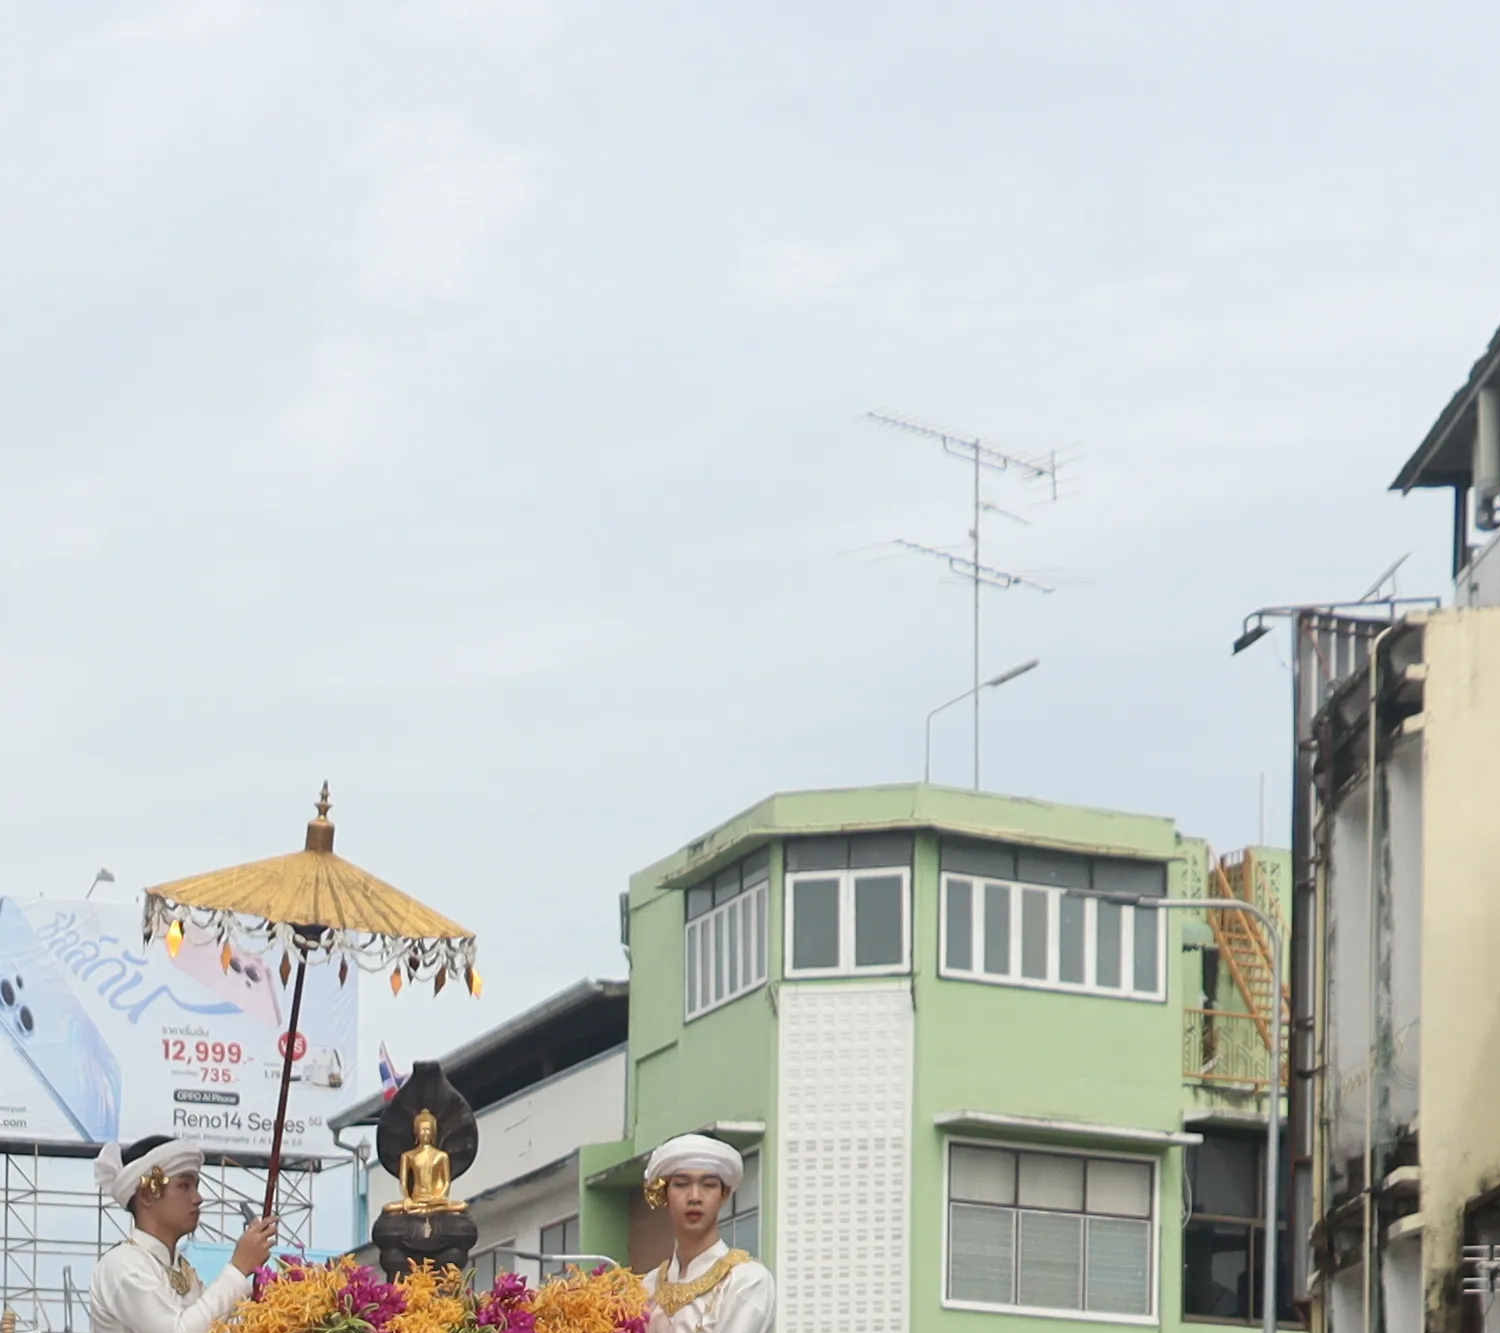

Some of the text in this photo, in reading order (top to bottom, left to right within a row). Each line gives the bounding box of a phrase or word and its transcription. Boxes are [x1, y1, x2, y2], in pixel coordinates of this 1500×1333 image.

[177, 1091, 202, 1101] OPPO
[212, 1093, 238, 1103] Phone
[172, 1108, 323, 1134] Reno14 Sees 5G
